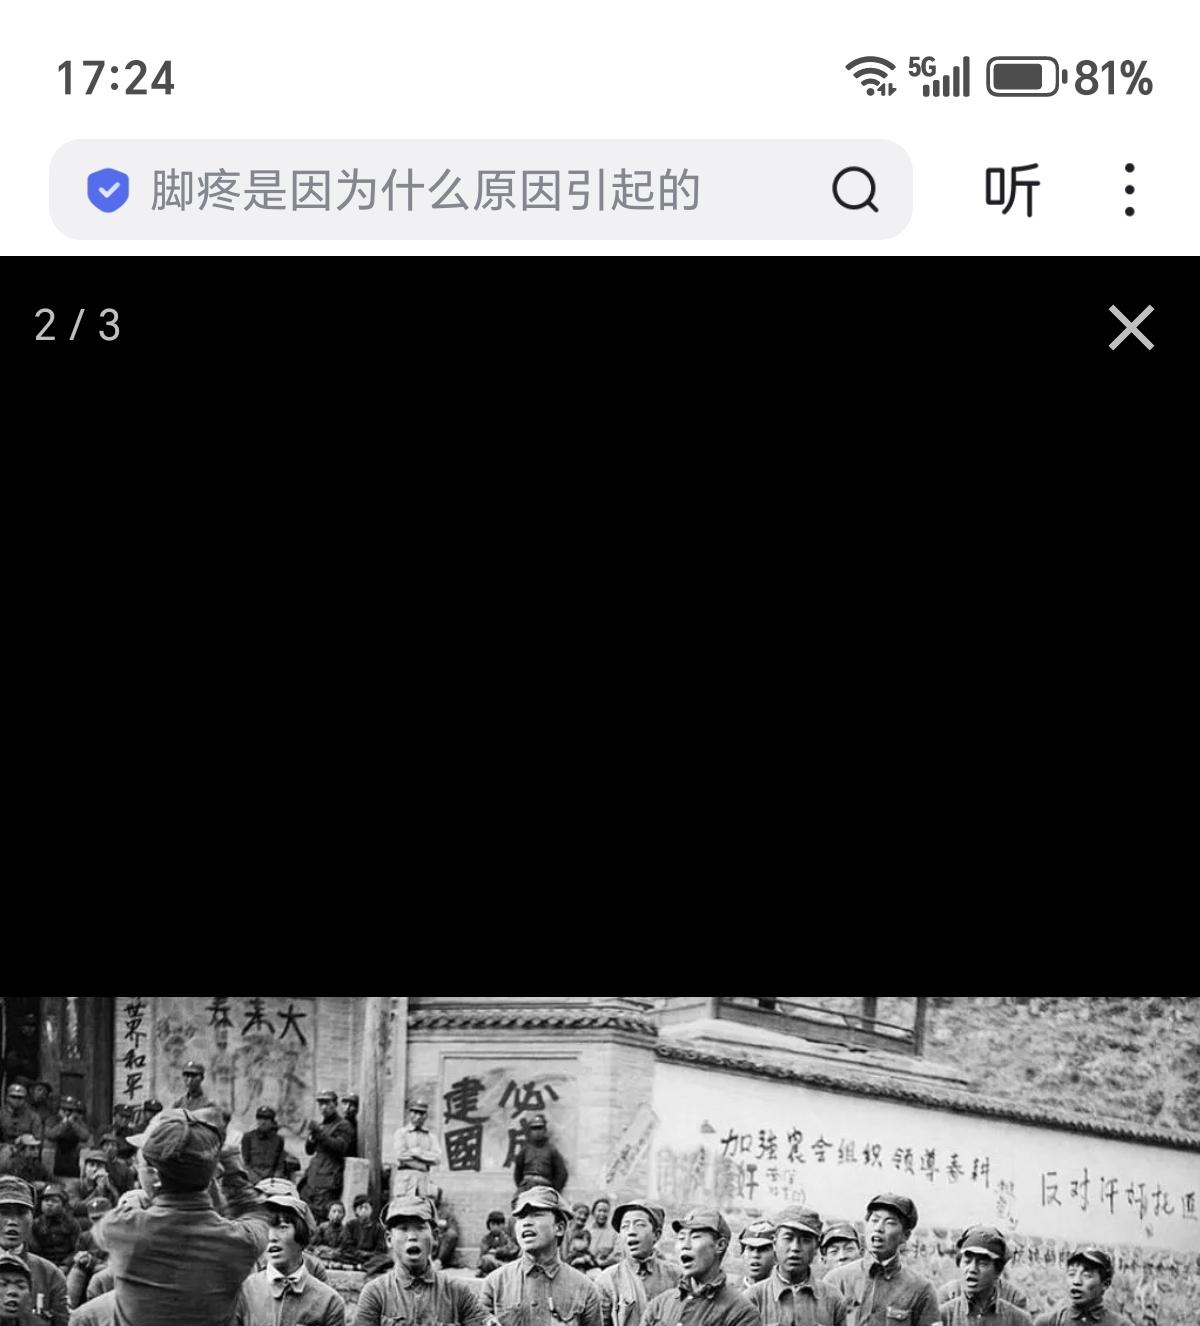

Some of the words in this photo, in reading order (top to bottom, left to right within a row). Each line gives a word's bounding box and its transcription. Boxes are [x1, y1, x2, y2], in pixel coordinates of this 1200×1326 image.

[58, 59, 175, 95] 17:24
[908, 56, 937, 78] 5G
[1074, 59, 1154, 96] 81%
[151, 167, 700, 212] 脚疼是因为什么原因引起的
[985, 162, 1041, 218] 听
